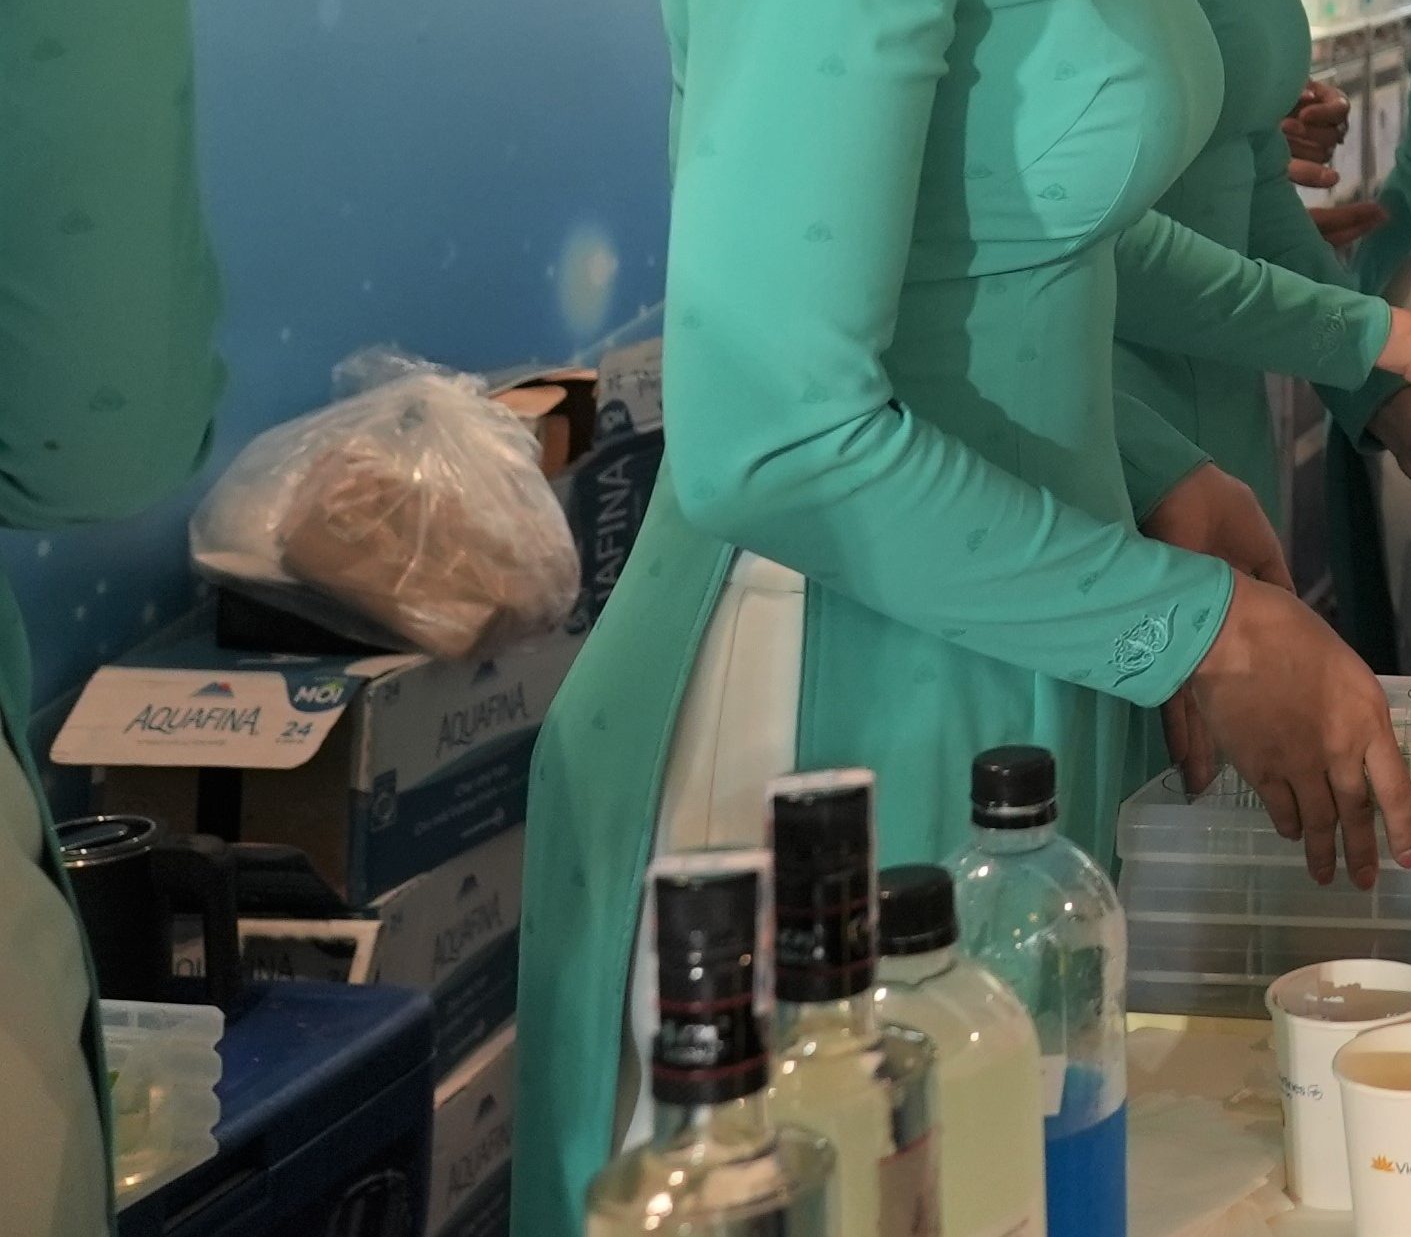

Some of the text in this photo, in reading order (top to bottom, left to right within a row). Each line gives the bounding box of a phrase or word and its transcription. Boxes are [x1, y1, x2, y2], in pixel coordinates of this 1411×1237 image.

[123, 703, 263, 735] AQUAFINA
[280, 721, 314, 738] 24
[435, 681, 530, 758] AQUAFINA
